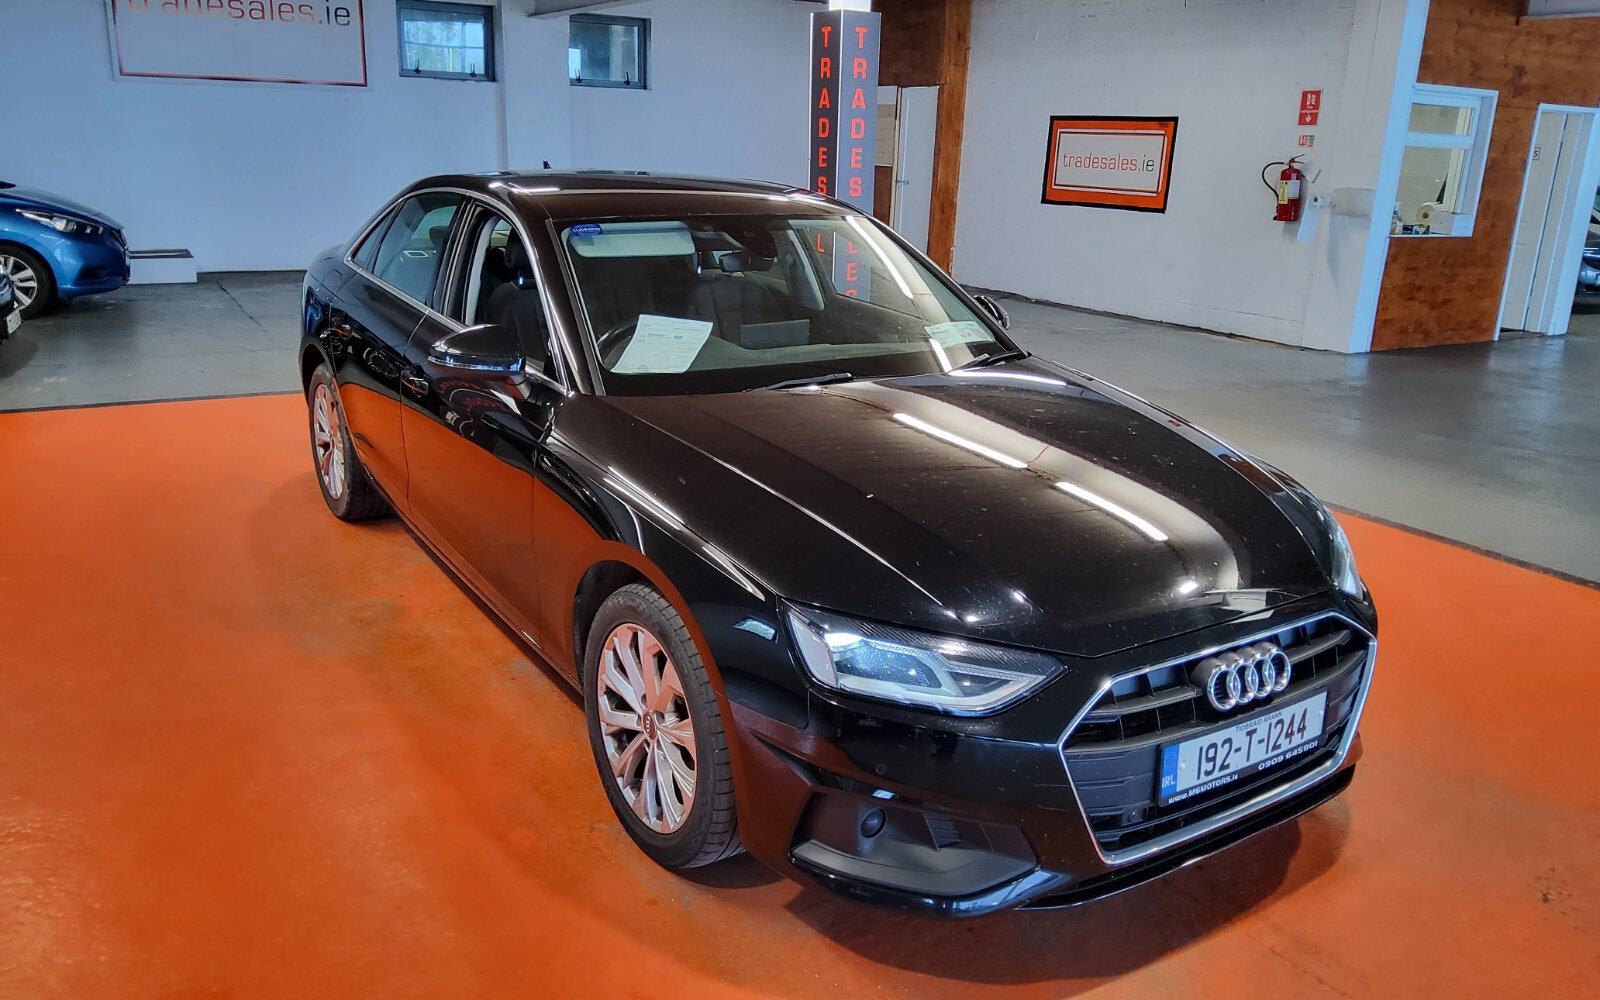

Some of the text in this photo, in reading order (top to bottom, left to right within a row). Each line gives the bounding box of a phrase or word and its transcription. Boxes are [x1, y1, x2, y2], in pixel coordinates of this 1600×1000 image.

[1062, 152, 1155, 173] tradesales.ie
[1196, 707, 1308, 781] 192-T-1244
[1257, 755, 1284, 771] 0909
[1161, 774, 1177, 790] IRL
